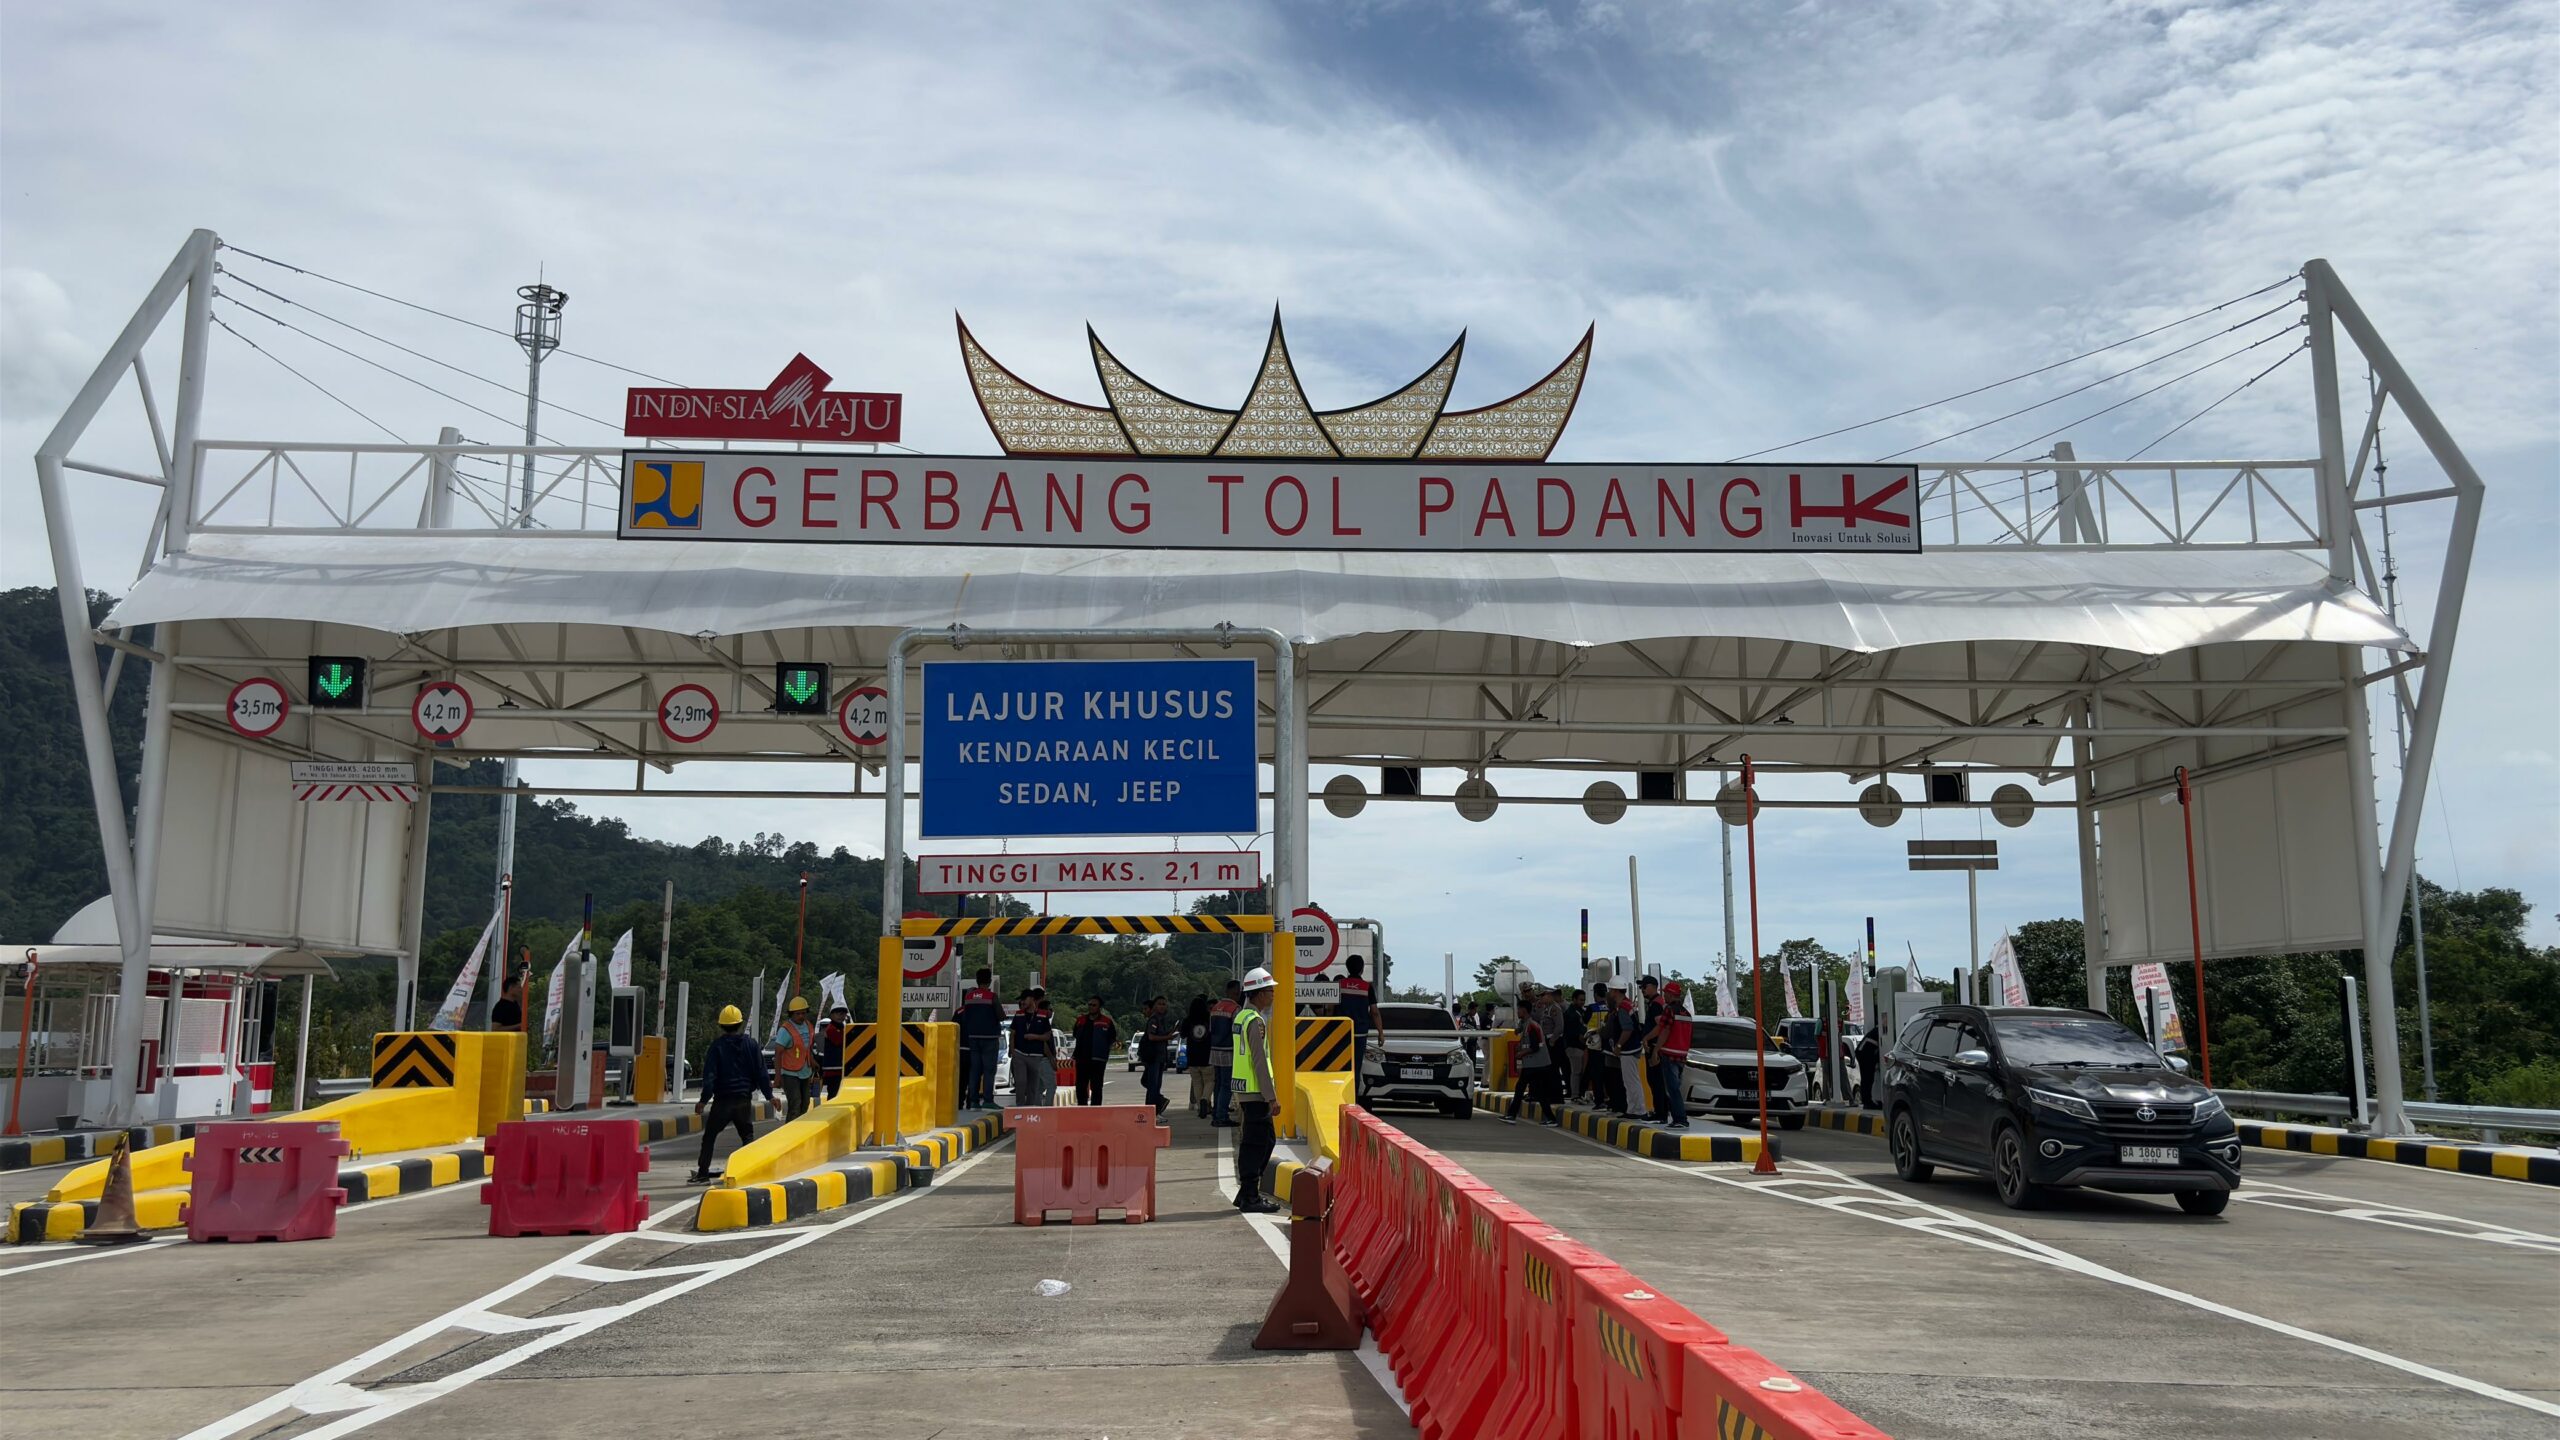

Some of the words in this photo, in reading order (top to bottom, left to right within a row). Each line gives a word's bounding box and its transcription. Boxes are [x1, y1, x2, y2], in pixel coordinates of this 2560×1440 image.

[789, 397, 896, 437] MAJU
[733, 467, 1151, 535] GERBANG
[1207, 475, 1361, 536] TOL
[1419, 477, 1763, 538] PADANG
[1789, 474, 1910, 528] HK
[1792, 532, 1832, 543] Inovasi
[1838, 532, 1872, 543] Untuk
[1876, 533, 1911, 544] Solusi
[423, 704, 444, 721] 4,2
[447, 706, 461, 719] m
[947, 692, 1064, 722] LAJUR
[1084, 690, 1234, 720] KHUSUS
[850, 708, 870, 726] 4,2
[874, 711, 887, 724] m
[959, 740, 1129, 763] KENDARAAN
[1144, 739, 1220, 761] KECIL
[999, 783, 1097, 808] SEDAN,
[1117, 781, 1181, 802] JEEP
[940, 864, 1038, 884] TINGGI
[1058, 862, 1145, 882] MAKS.
[1164, 861, 1200, 884] 2,1
[1217, 863, 1240, 880] m
[1292, 925, 1325, 933] ERBANG
[903, 992, 924, 1002] ELKAN
[927, 992, 949, 1002] KARTU
[1295, 988, 1315, 998] ELKAN
[1317, 988, 1338, 998] KARTU
[2122, 1147, 2134, 1158] BA
[2138, 1147, 2161, 1158] 1860
[2166, 1148, 2178, 1159] FG
